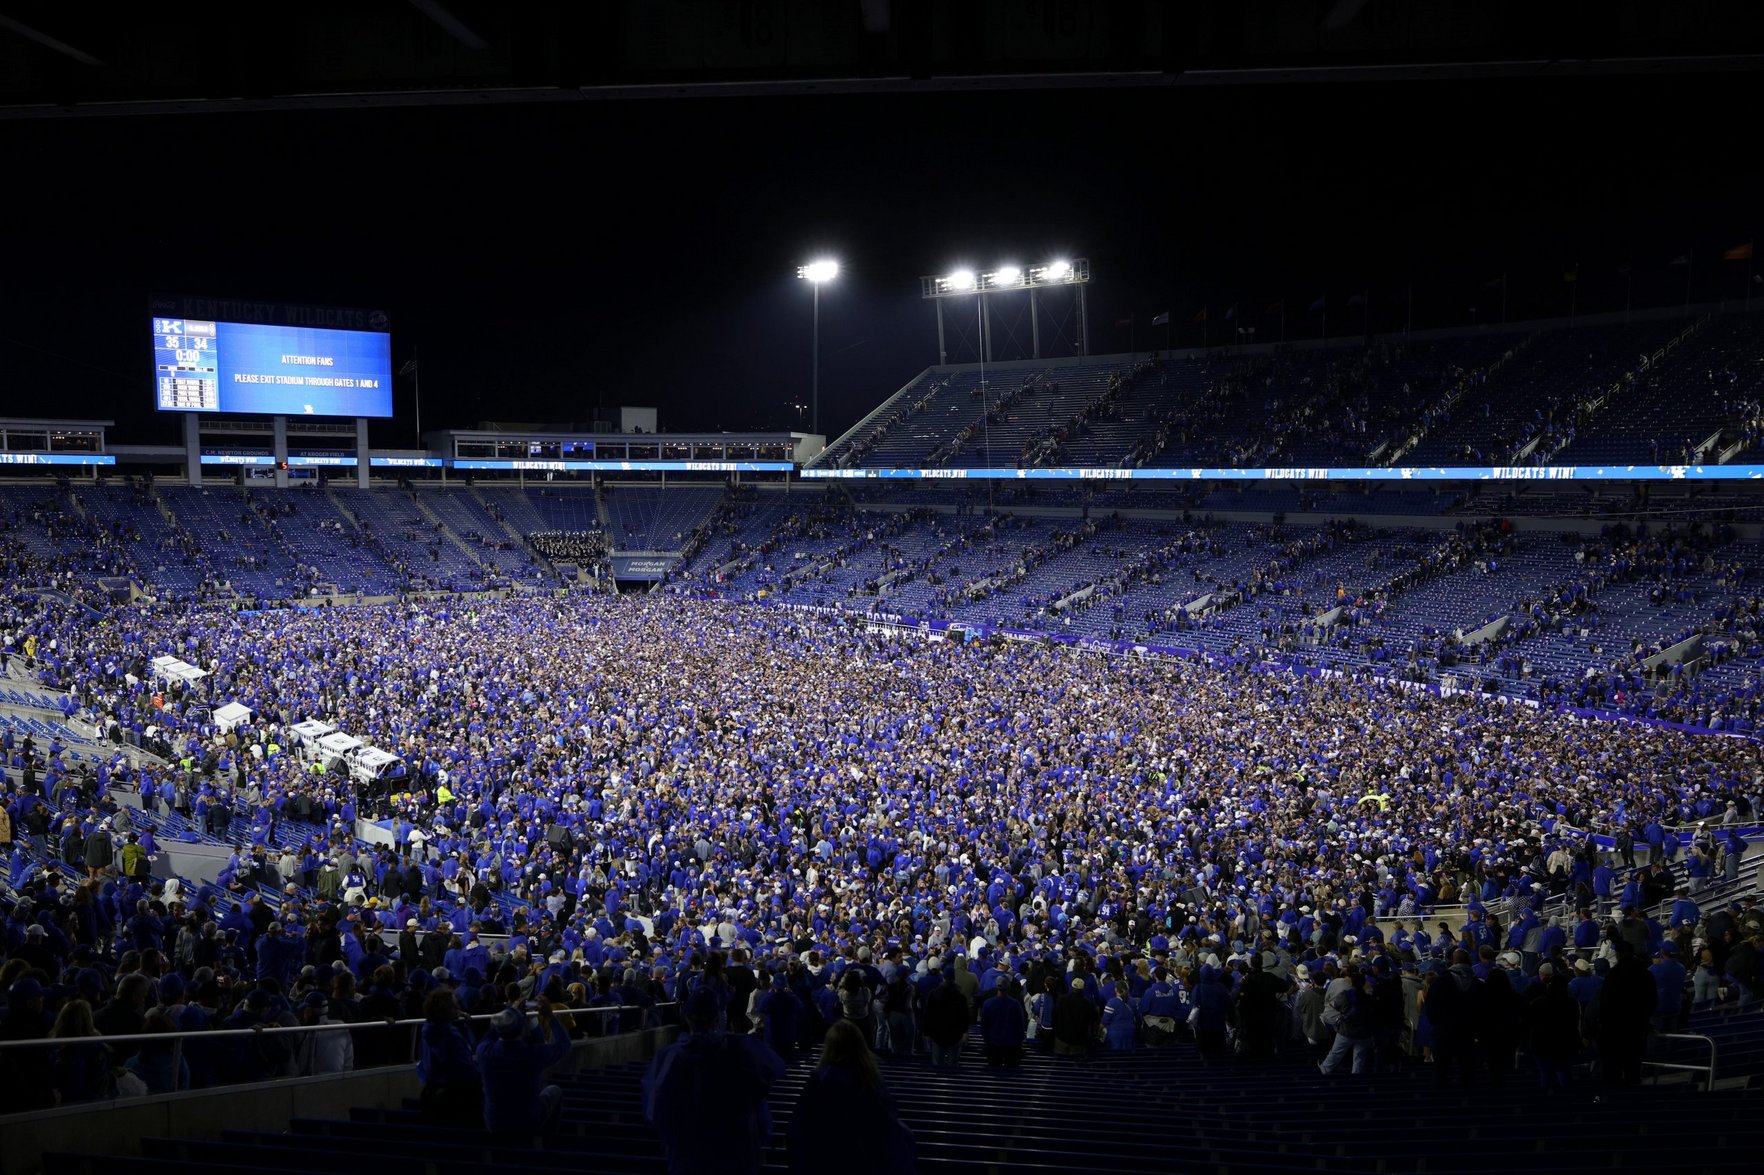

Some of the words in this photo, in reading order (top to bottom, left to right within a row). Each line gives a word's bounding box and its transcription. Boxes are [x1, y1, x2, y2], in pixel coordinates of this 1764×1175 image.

[183, 297, 275, 323] KENTUCKY
[286, 305, 365, 328] WILDCATS
[165, 335, 179, 348] 35
[194, 337, 208, 350] 34
[176, 350, 200, 362] 0:00
[281, 354, 316, 366] ATTENTION
[317, 357, 334, 367] FANS
[234, 373, 259, 384] PLEASE
[260, 375, 275, 384] EXIT
[275, 375, 304, 385] STADIUM
[304, 377, 334, 387] THROUGH
[334, 378, 354, 388] GATES
[355, 379, 359, 388] 1
[360, 379, 373, 388] AND
[373, 380, 379, 389] 4
[0, 454, 13, 464] TS
[512, 461, 547, 469] WILDCATS
[549, 461, 566, 470] WIN!
[686, 463, 720, 471] WILDCATS
[721, 463, 737, 471] WIN!
[920, 469, 951, 478] WILDCATS
[1079, 469, 1114, 479] WILDCATS
[1115, 469, 1133, 479] WIN!
[1265, 468, 1306, 479] WILDCATS
[1308, 468, 1328, 479] WIN!
[1492, 467, 1545, 479] WILDCATS
[1548, 467, 1574, 479] WIN!
